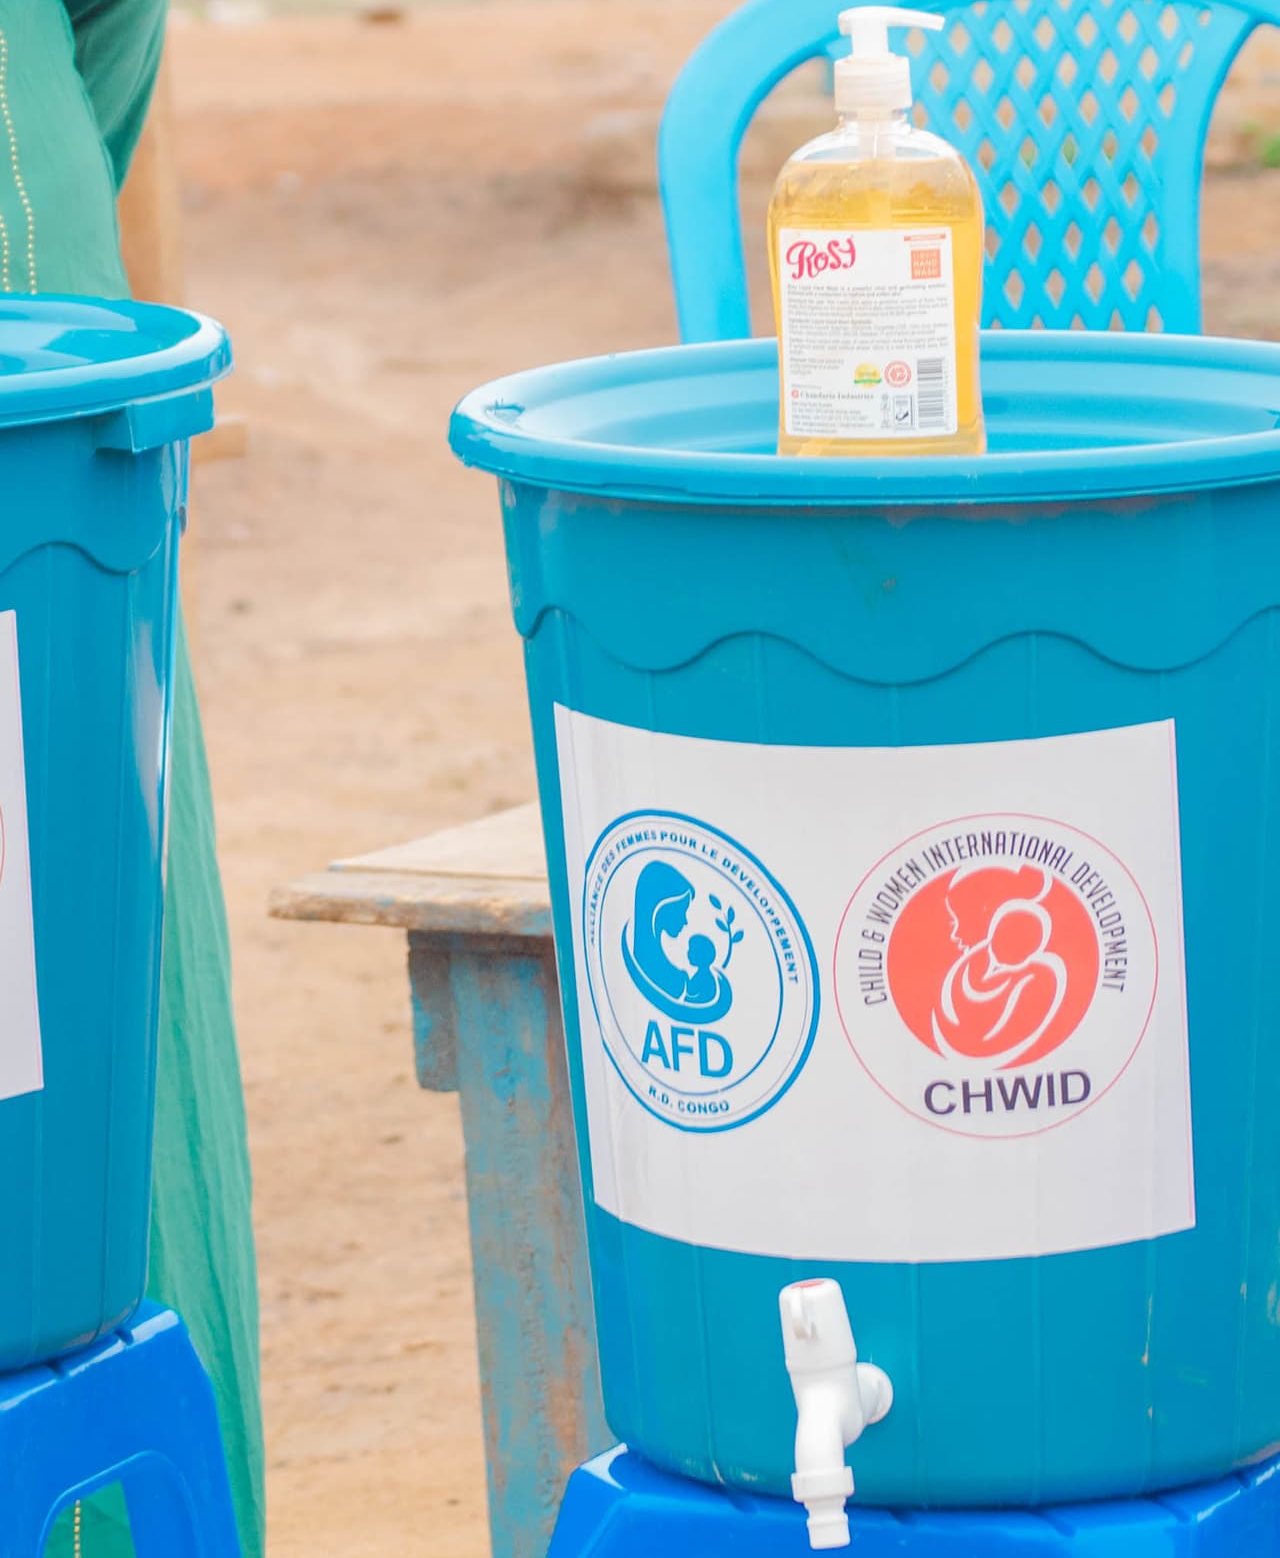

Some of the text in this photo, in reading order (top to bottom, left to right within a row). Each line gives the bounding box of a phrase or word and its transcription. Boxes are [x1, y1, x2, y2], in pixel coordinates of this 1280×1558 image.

[601, 848, 616, 873] DES
[615, 829, 658, 854] FEMMES
[660, 830, 698, 849] POUR
[701, 844, 718, 859] LE
[722, 857, 799, 984] DÉVELOPPEMENT
[858, 831, 1128, 1006] CHILD & WOMEN INTERNATIONAL DEVELOPMENT
[641, 1019, 734, 1078] AFD
[648, 1084, 730, 1114] R.D. CONGO
[923, 1069, 1091, 1115] CHWID
